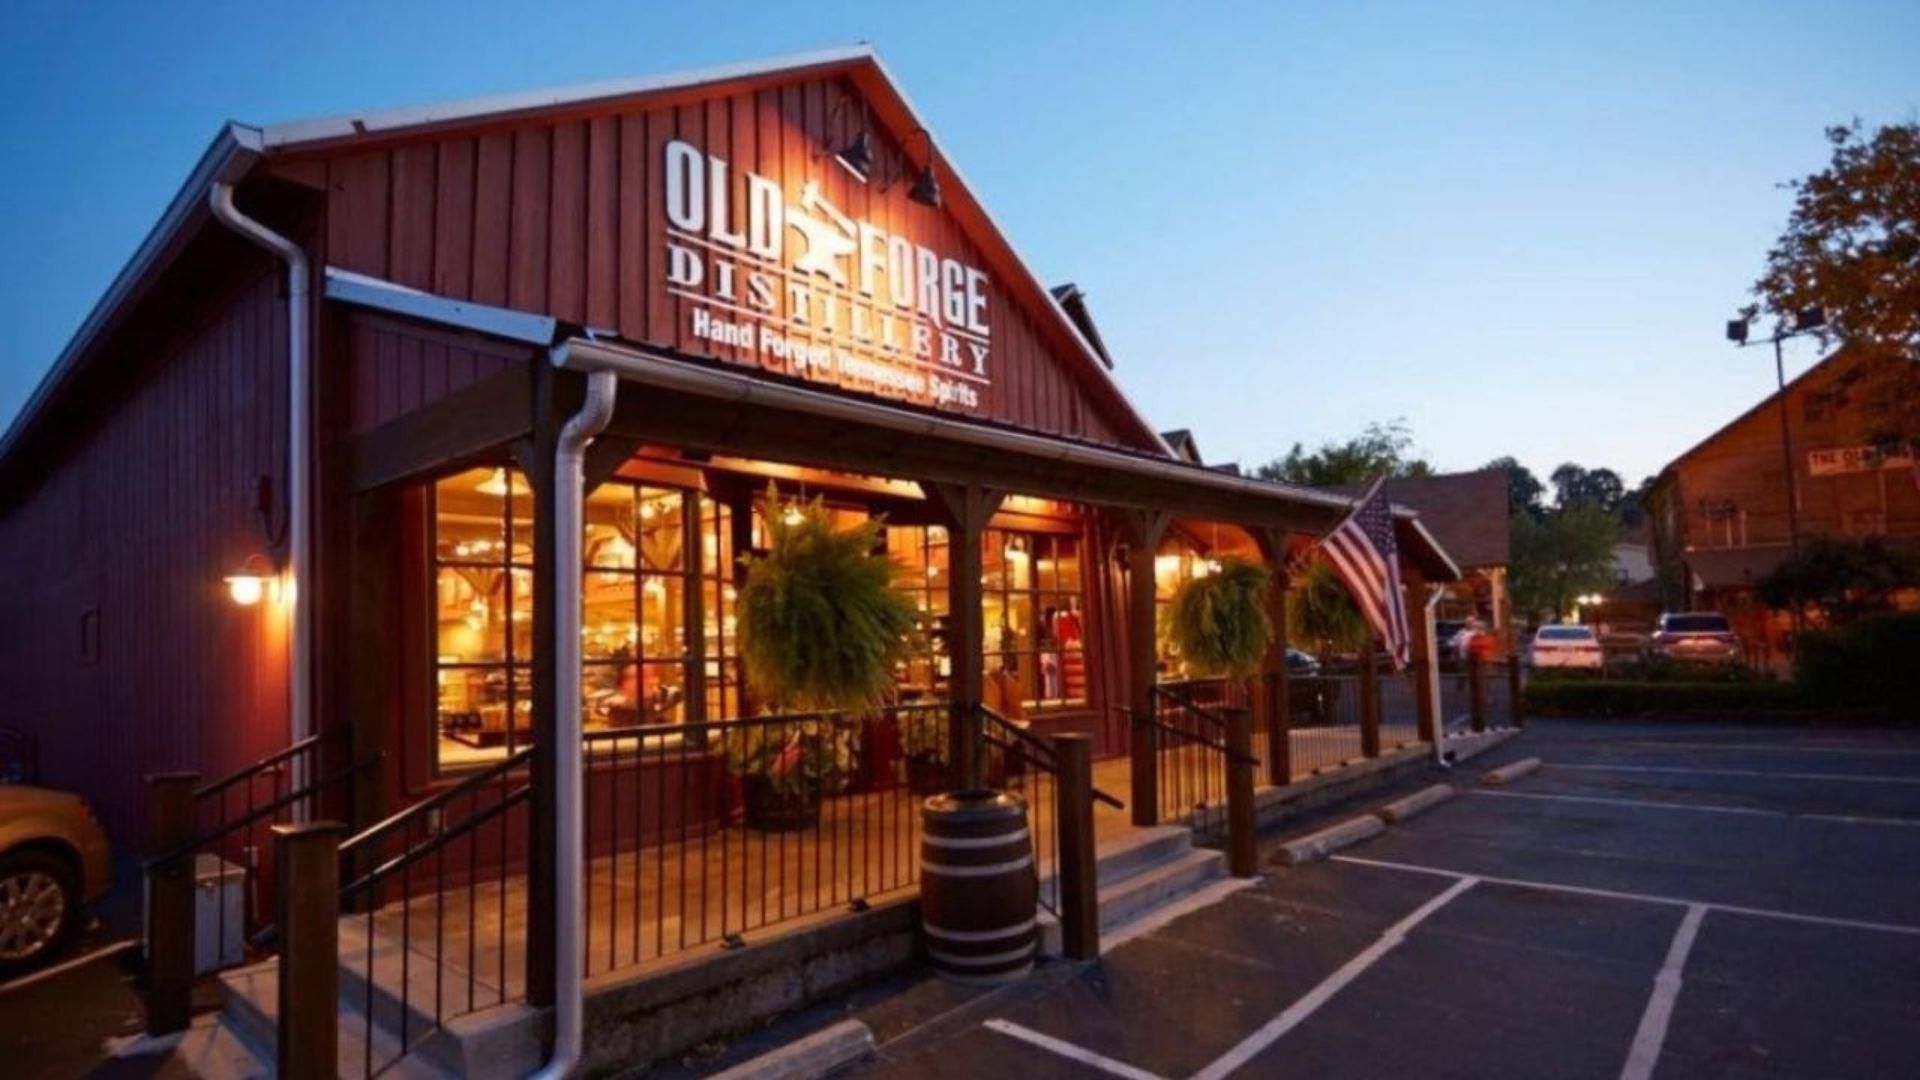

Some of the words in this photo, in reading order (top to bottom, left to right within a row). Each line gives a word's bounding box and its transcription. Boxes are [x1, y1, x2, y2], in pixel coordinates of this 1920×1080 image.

[666, 140, 783, 263] OLD
[858, 219, 990, 337] FORGE
[667, 243, 990, 376] DISTILLERY
[693, 307, 755, 349] Hand
[760, 324, 832, 369] Forged
[929, 373, 978, 408] Spirits
